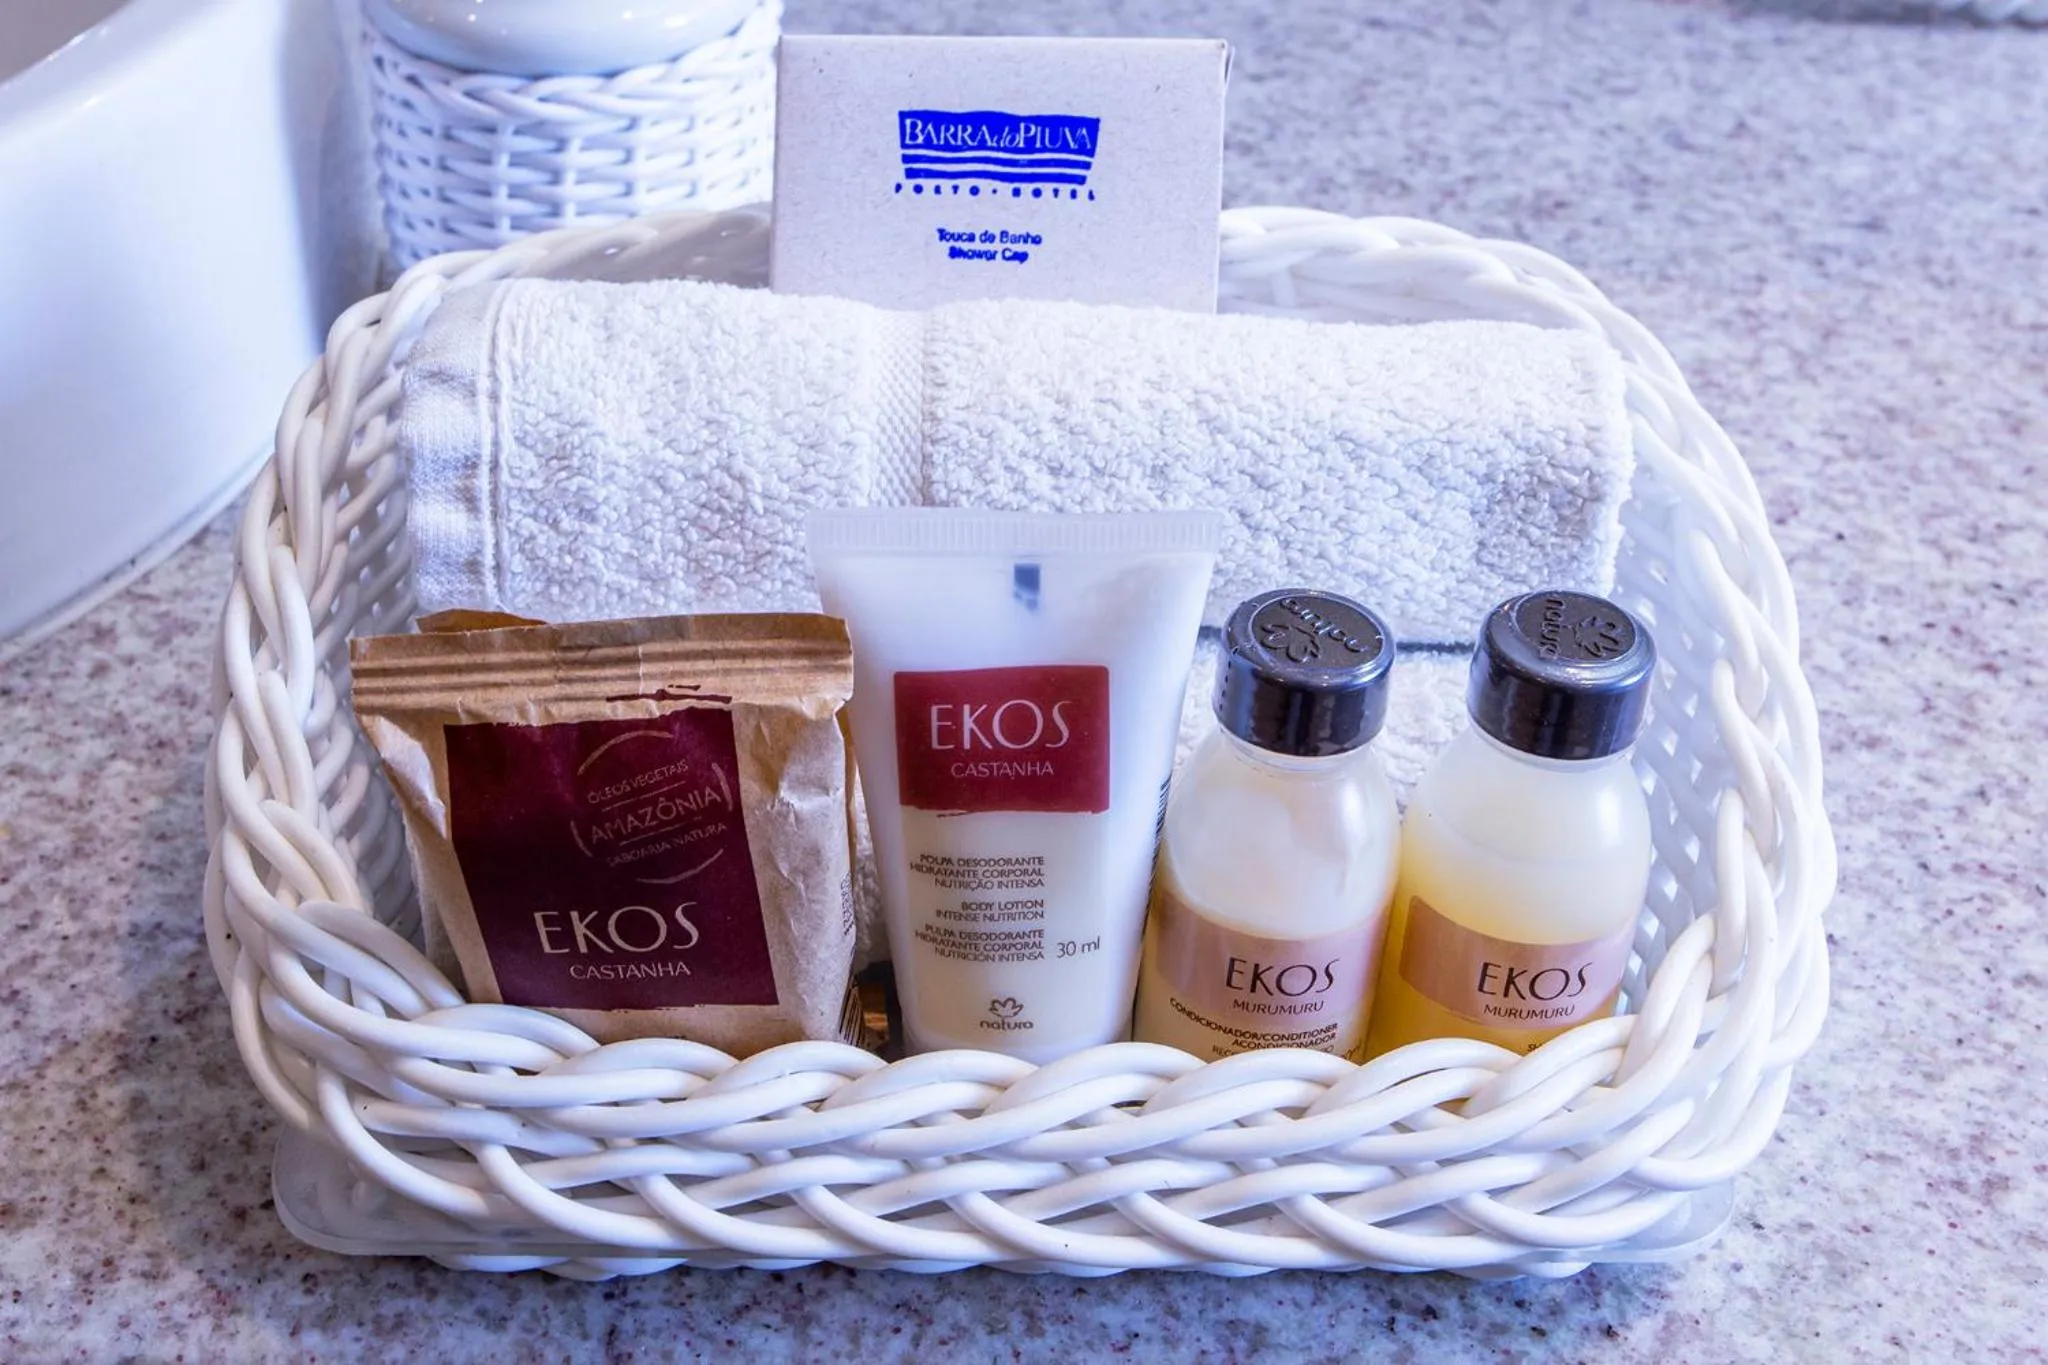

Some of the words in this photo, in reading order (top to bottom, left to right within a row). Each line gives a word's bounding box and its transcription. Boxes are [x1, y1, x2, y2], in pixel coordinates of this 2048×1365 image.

[937, 228, 976, 243] Touca
[979, 230, 996, 244] de
[1000, 230, 1043, 245] Banho
[948, 246, 998, 261] Shower
[1001, 247, 1029, 264] Cap
[930, 699, 1073, 750] EKOS
[951, 761, 1054, 778] CASTANHA
[590, 786, 722, 845] AMAZÔNIA
[920, 854, 954, 866] POLPA
[957, 856, 1044, 867] DESODORANTE
[910, 862, 979, 879] HIDRATANTE
[982, 868, 1044, 878] CORPORAL
[935, 878, 994, 891] NUTRIÇÃO
[998, 878, 1045, 889] INTENSA
[961, 901, 995, 911] BODY
[998, 899, 1044, 911] LOTION
[935, 909, 980, 921] INTENSE
[982, 910, 1044, 922] NUTRITION
[533, 901, 700, 954] EKOS
[959, 929, 1044, 941] DESODORANTE
[915, 930, 980, 952] HIDRATANTE
[983, 940, 1044, 952] CORPORAL
[1056, 940, 1077, 959] 30
[1081, 936, 1100, 954] ml
[998, 951, 1045, 963] INTENSA
[569, 960, 691, 980] CASTANHA
[1226, 957, 1340, 997] EKOS
[1477, 961, 1593, 1001] EKOS
[1231, 999, 1324, 1016] MURUMURU
[1484, 1003, 1575, 1019] MURUMURU
[979, 1019, 1034, 1031] natura
